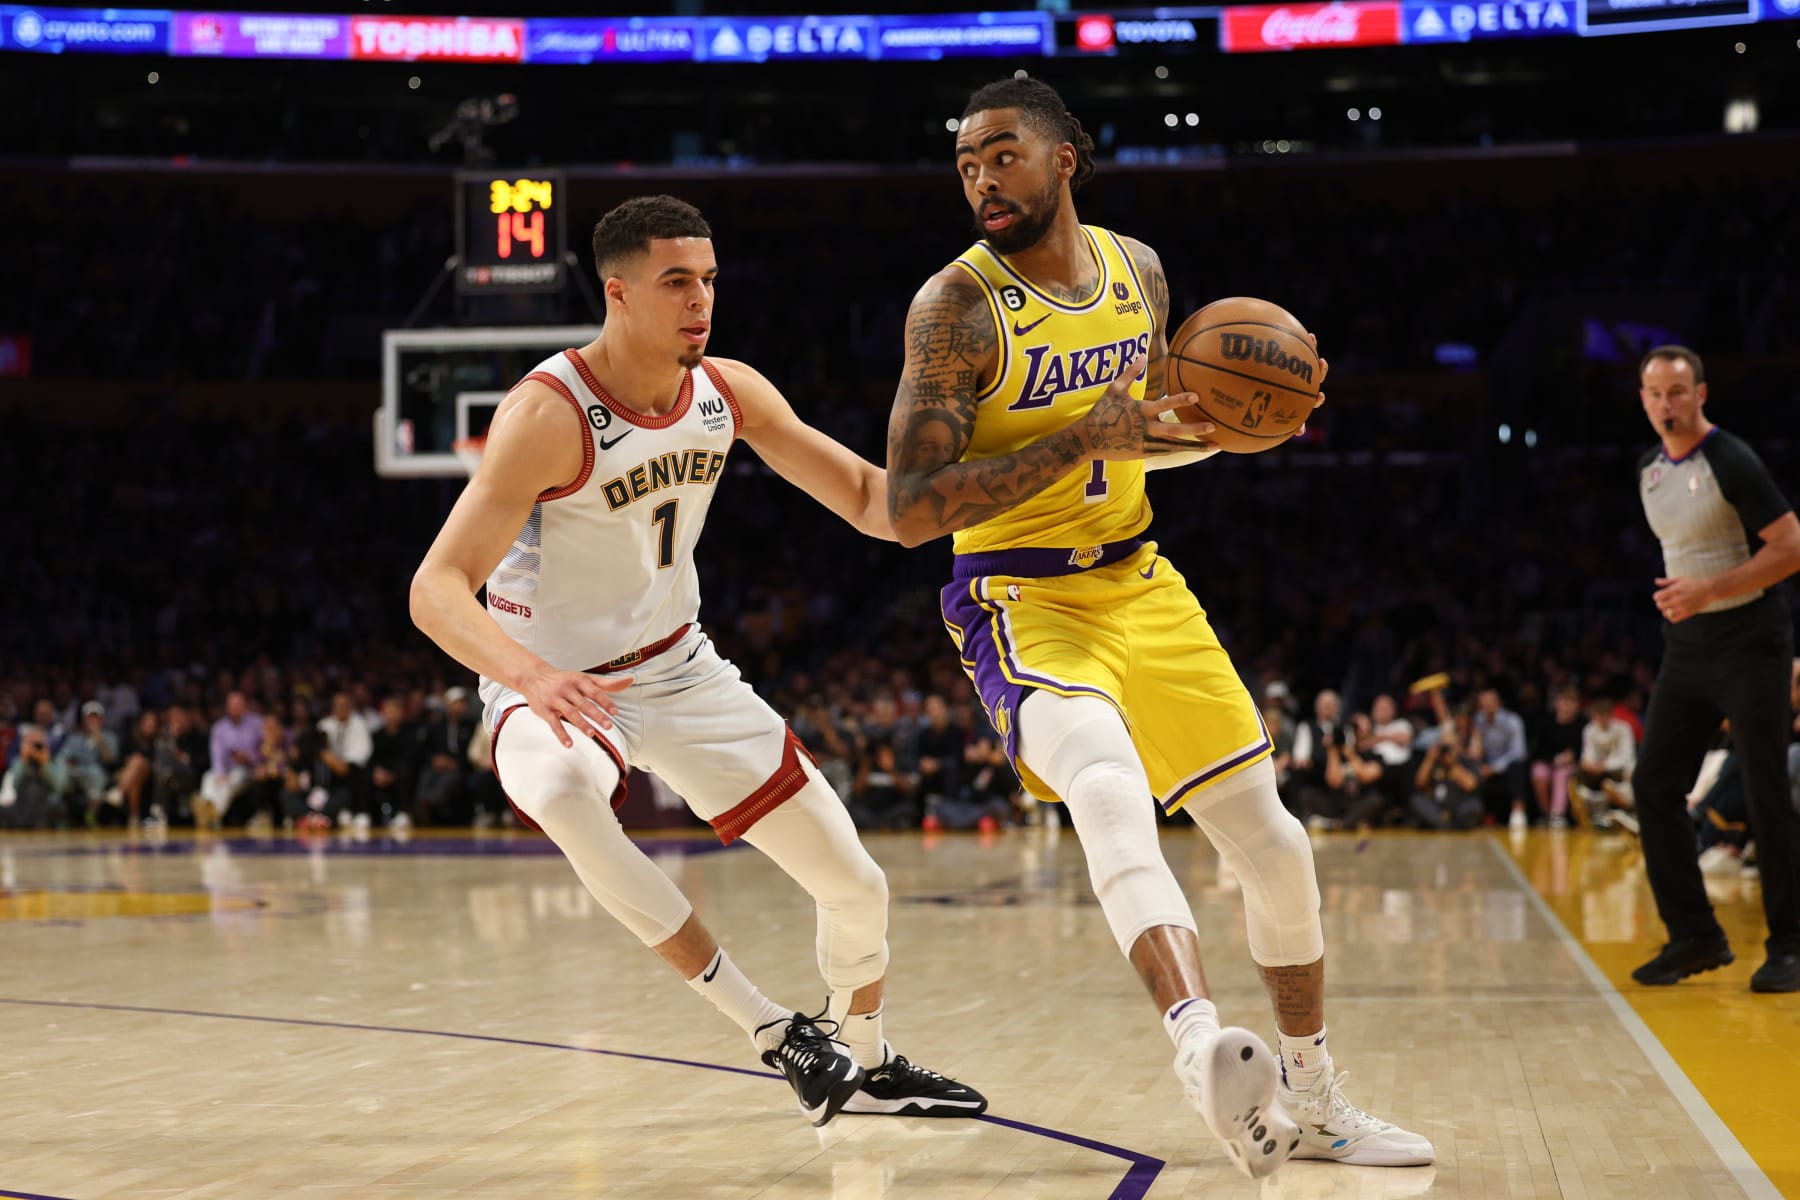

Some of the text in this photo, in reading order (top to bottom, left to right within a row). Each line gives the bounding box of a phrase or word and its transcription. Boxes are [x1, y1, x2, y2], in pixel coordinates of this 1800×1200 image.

[1451, 1, 1570, 33] DELTA
[355, 21, 517, 57] TOSHIBA
[746, 24, 865, 53] DELTA
[1115, 20, 1197, 43] TOYOTA
[498, 211, 544, 258] 14
[1002, 288, 1022, 309] 6
[1114, 300, 1142, 316] bibigo
[1007, 332, 1150, 412] LAKERS
[1220, 332, 1313, 385] Wilson
[589, 407, 609, 428] 6
[698, 398, 724, 418] WU
[702, 414, 728, 427] Western
[707, 422, 726, 433] Union
[600, 448, 726, 512] DENVER
[651, 498, 680, 570] 1
[488, 591, 532, 619] NUGGETS
